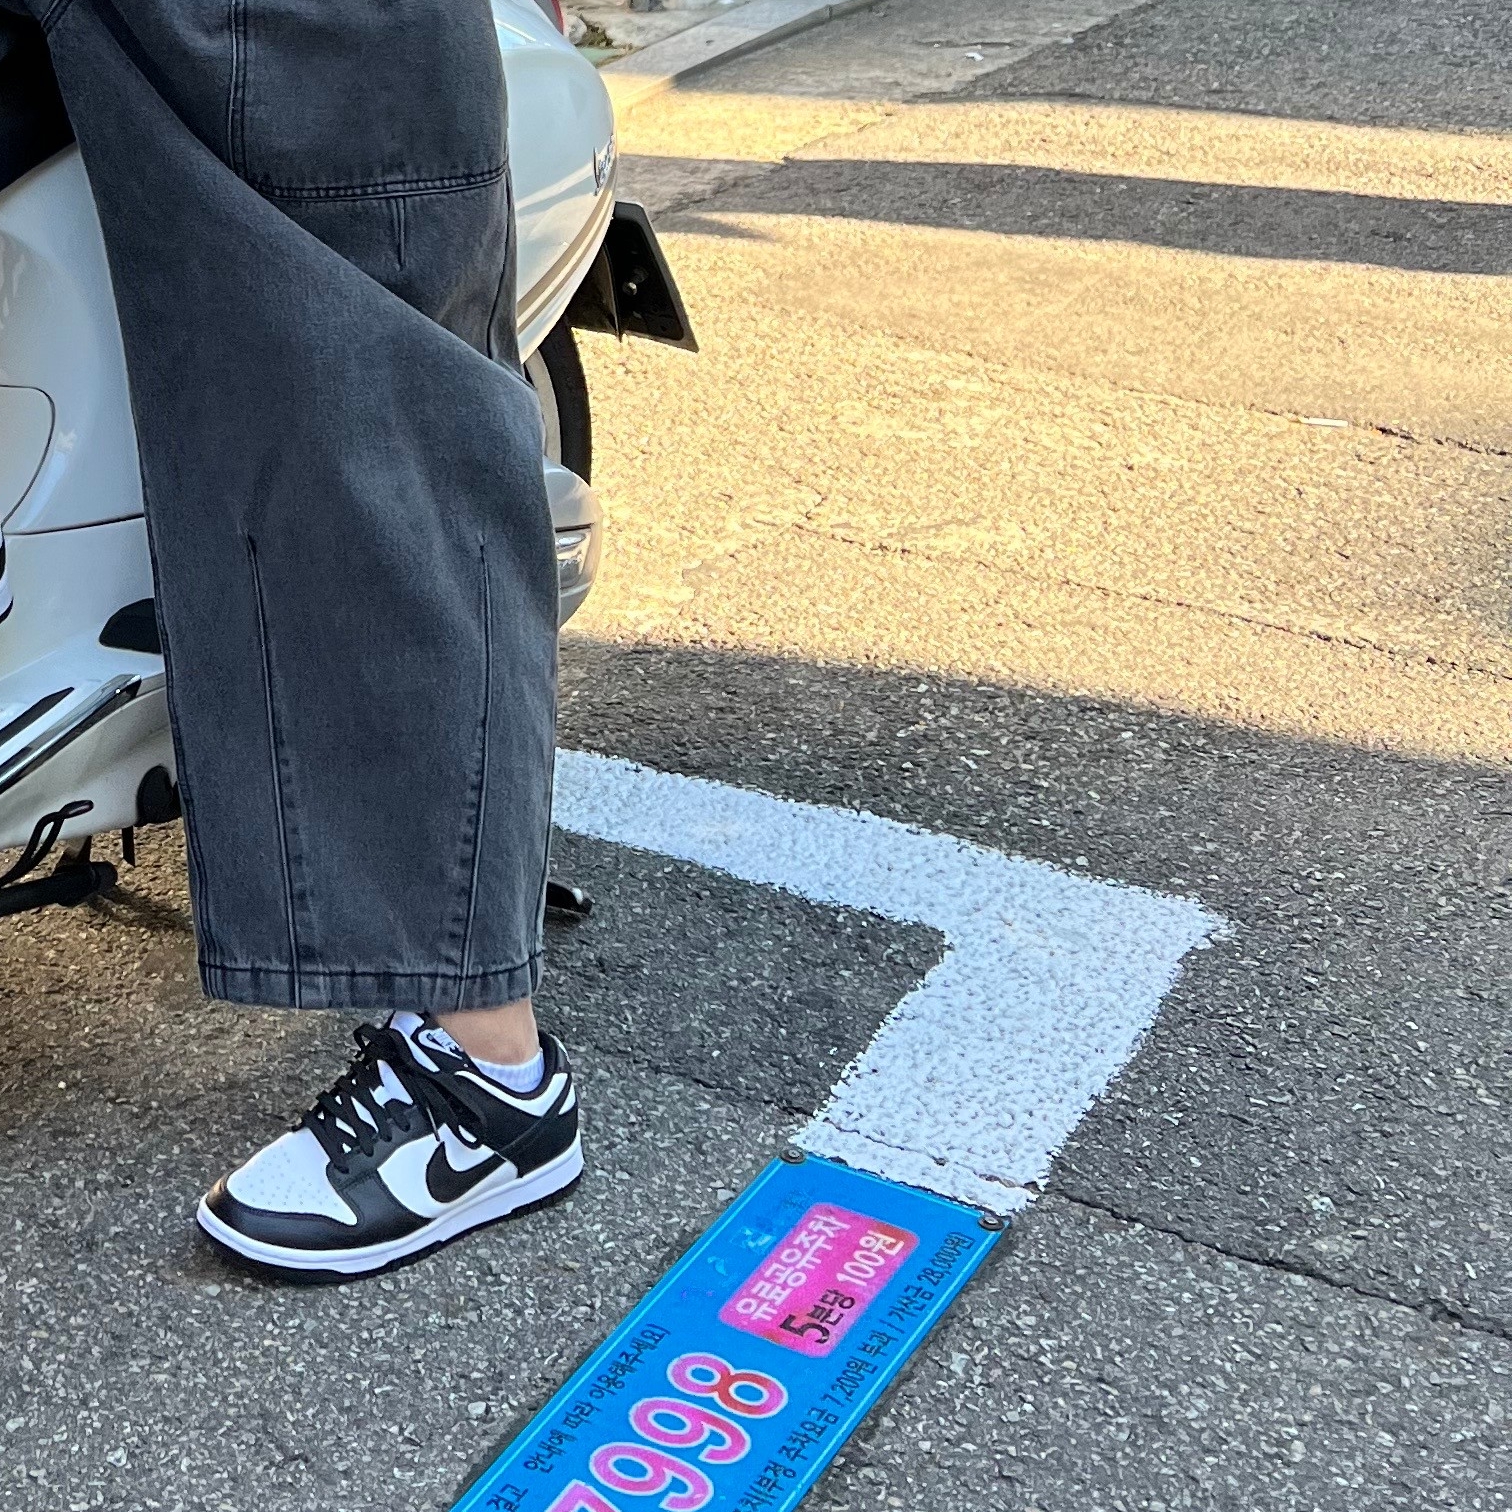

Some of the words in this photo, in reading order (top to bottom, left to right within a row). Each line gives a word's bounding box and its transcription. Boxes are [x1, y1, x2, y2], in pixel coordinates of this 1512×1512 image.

[735, 1214, 851, 1321] 유료공유주차
[779, 1289, 856, 1344] 5분당
[837, 1229, 904, 1286] 100원
[777, 1407, 839, 1461] 주차요금
[857, 1329, 891, 1358] 부과
[894, 1283, 934, 1319] 가산금
[523, 1429, 577, 1474] 안내에
[563, 1400, 602, 1429] 따라
